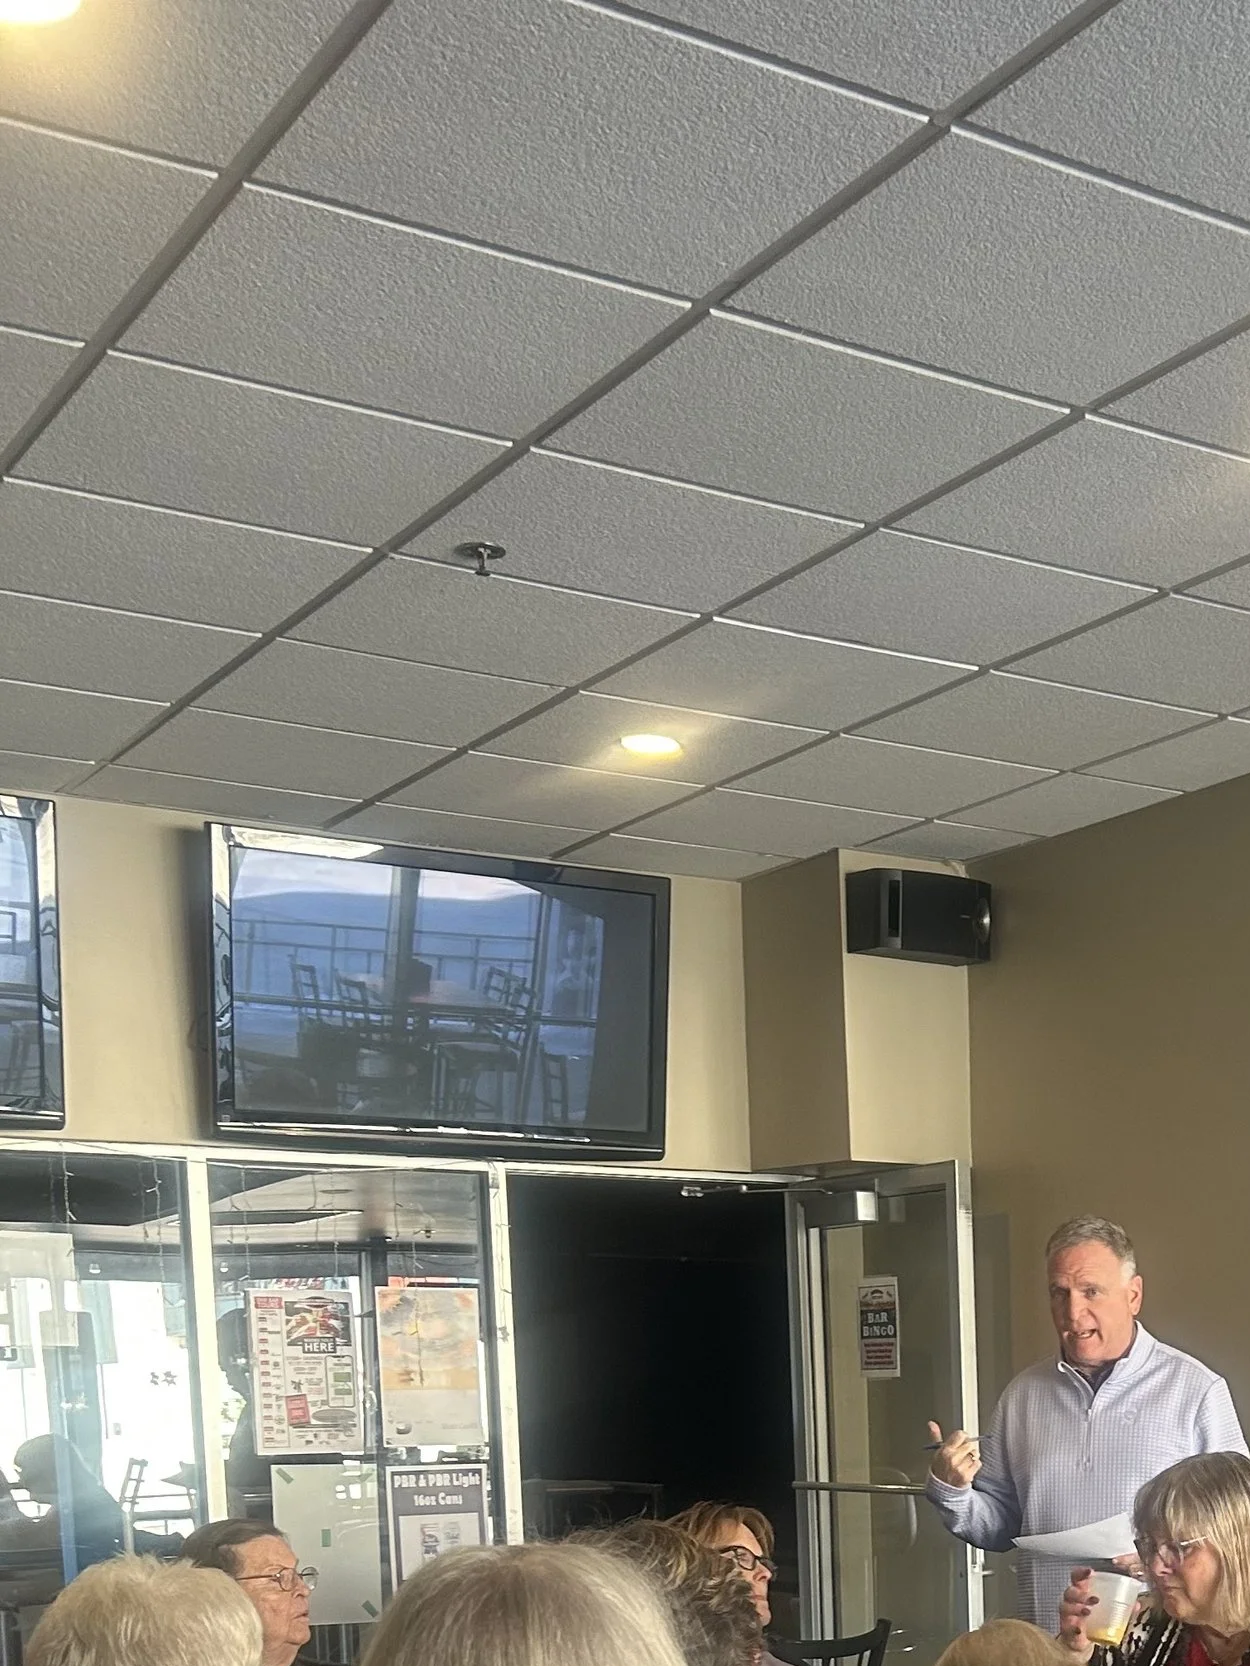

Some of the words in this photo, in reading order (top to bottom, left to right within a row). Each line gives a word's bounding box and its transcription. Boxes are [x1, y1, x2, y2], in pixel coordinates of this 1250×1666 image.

[867, 1311, 888, 1323] BAR
[304, 1342, 335, 1353] HERE
[393, 1474, 417, 1488] PBR
[418, 1474, 427, 1487] &
[428, 1473, 451, 1486] PBR
[452, 1472, 480, 1487] Light
